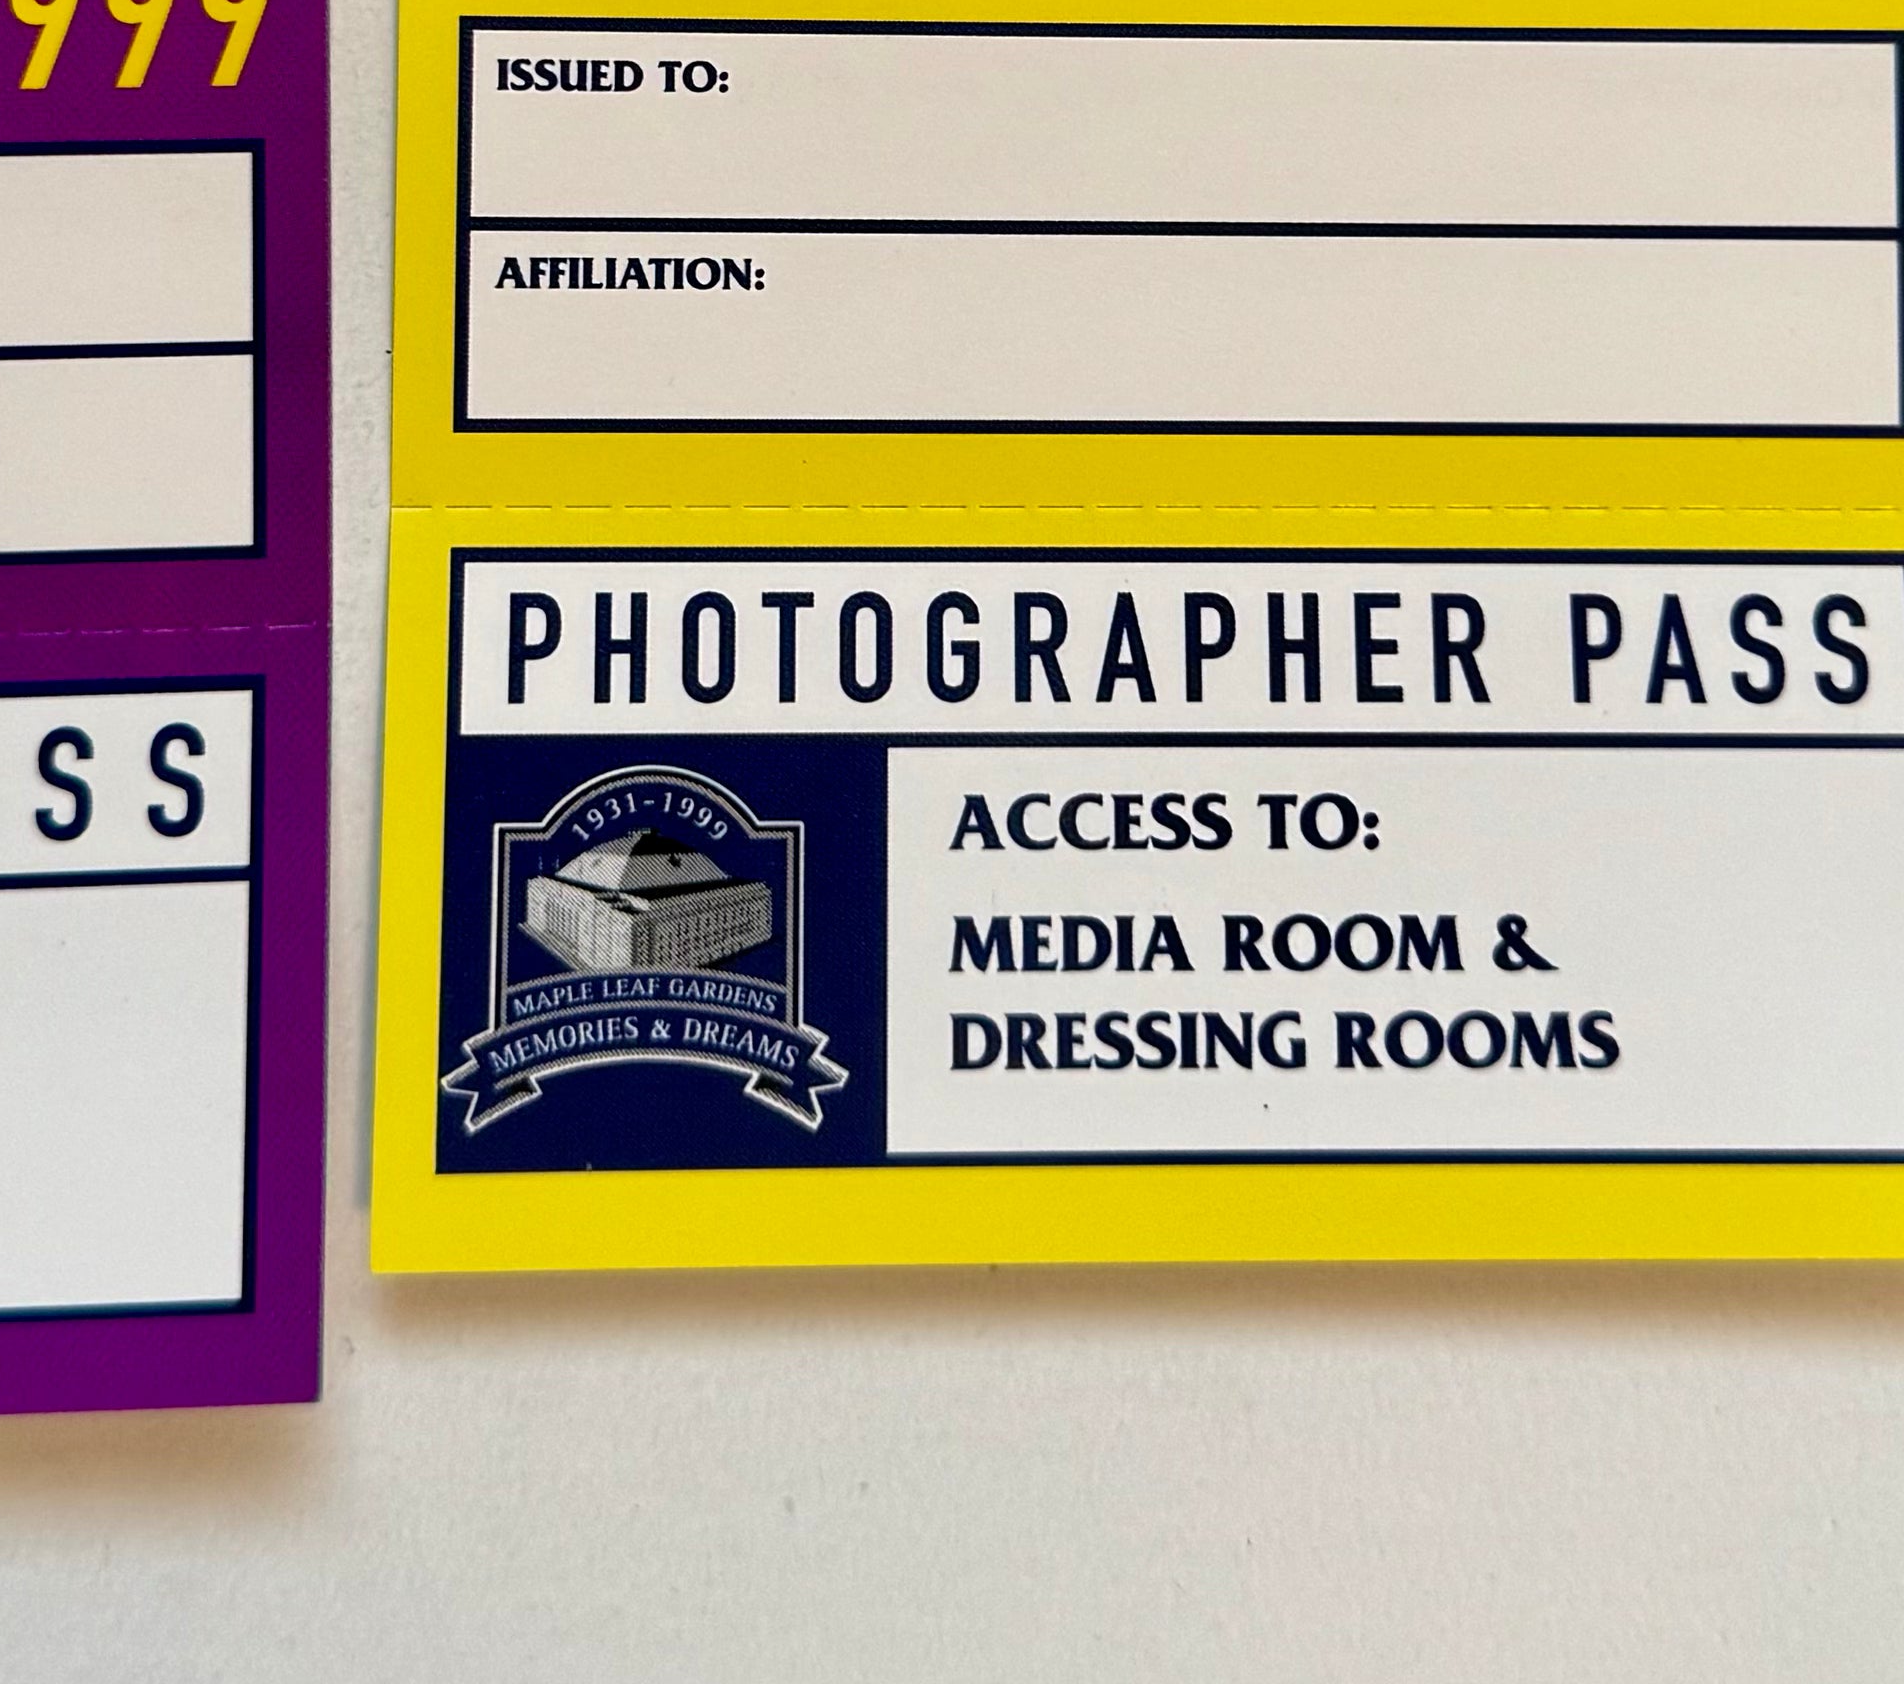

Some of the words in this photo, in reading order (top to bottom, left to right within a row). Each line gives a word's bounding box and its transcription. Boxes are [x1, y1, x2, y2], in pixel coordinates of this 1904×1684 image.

[496, 57, 646, 95] ISSUED
[658, 59, 732, 96] TO:
[494, 255, 768, 292] AFFILIATION:
[506, 589, 1490, 706] PHOTOGRAPHER
[1574, 593, 1874, 707] PASS
[572, 793, 728, 842] 1931-1999
[948, 791, 1234, 853] ACCESS
[1258, 792, 1381, 853] TO:
[948, 913, 1193, 975] MEDIA
[1222, 914, 1464, 975] ROOM
[1492, 914, 1558, 975] &
[513, 981, 596, 1013] MAPLE
[602, 977, 659, 997] LEAF
[668, 977, 778, 1010] GARDENS
[490, 1018, 639, 1069] MEMORIES
[651, 1018, 673, 1039] &
[683, 1018, 799, 1069] DREAMS
[948, 1010, 1310, 1072] DRESSING
[1335, 1010, 1620, 1072] ROOMS
